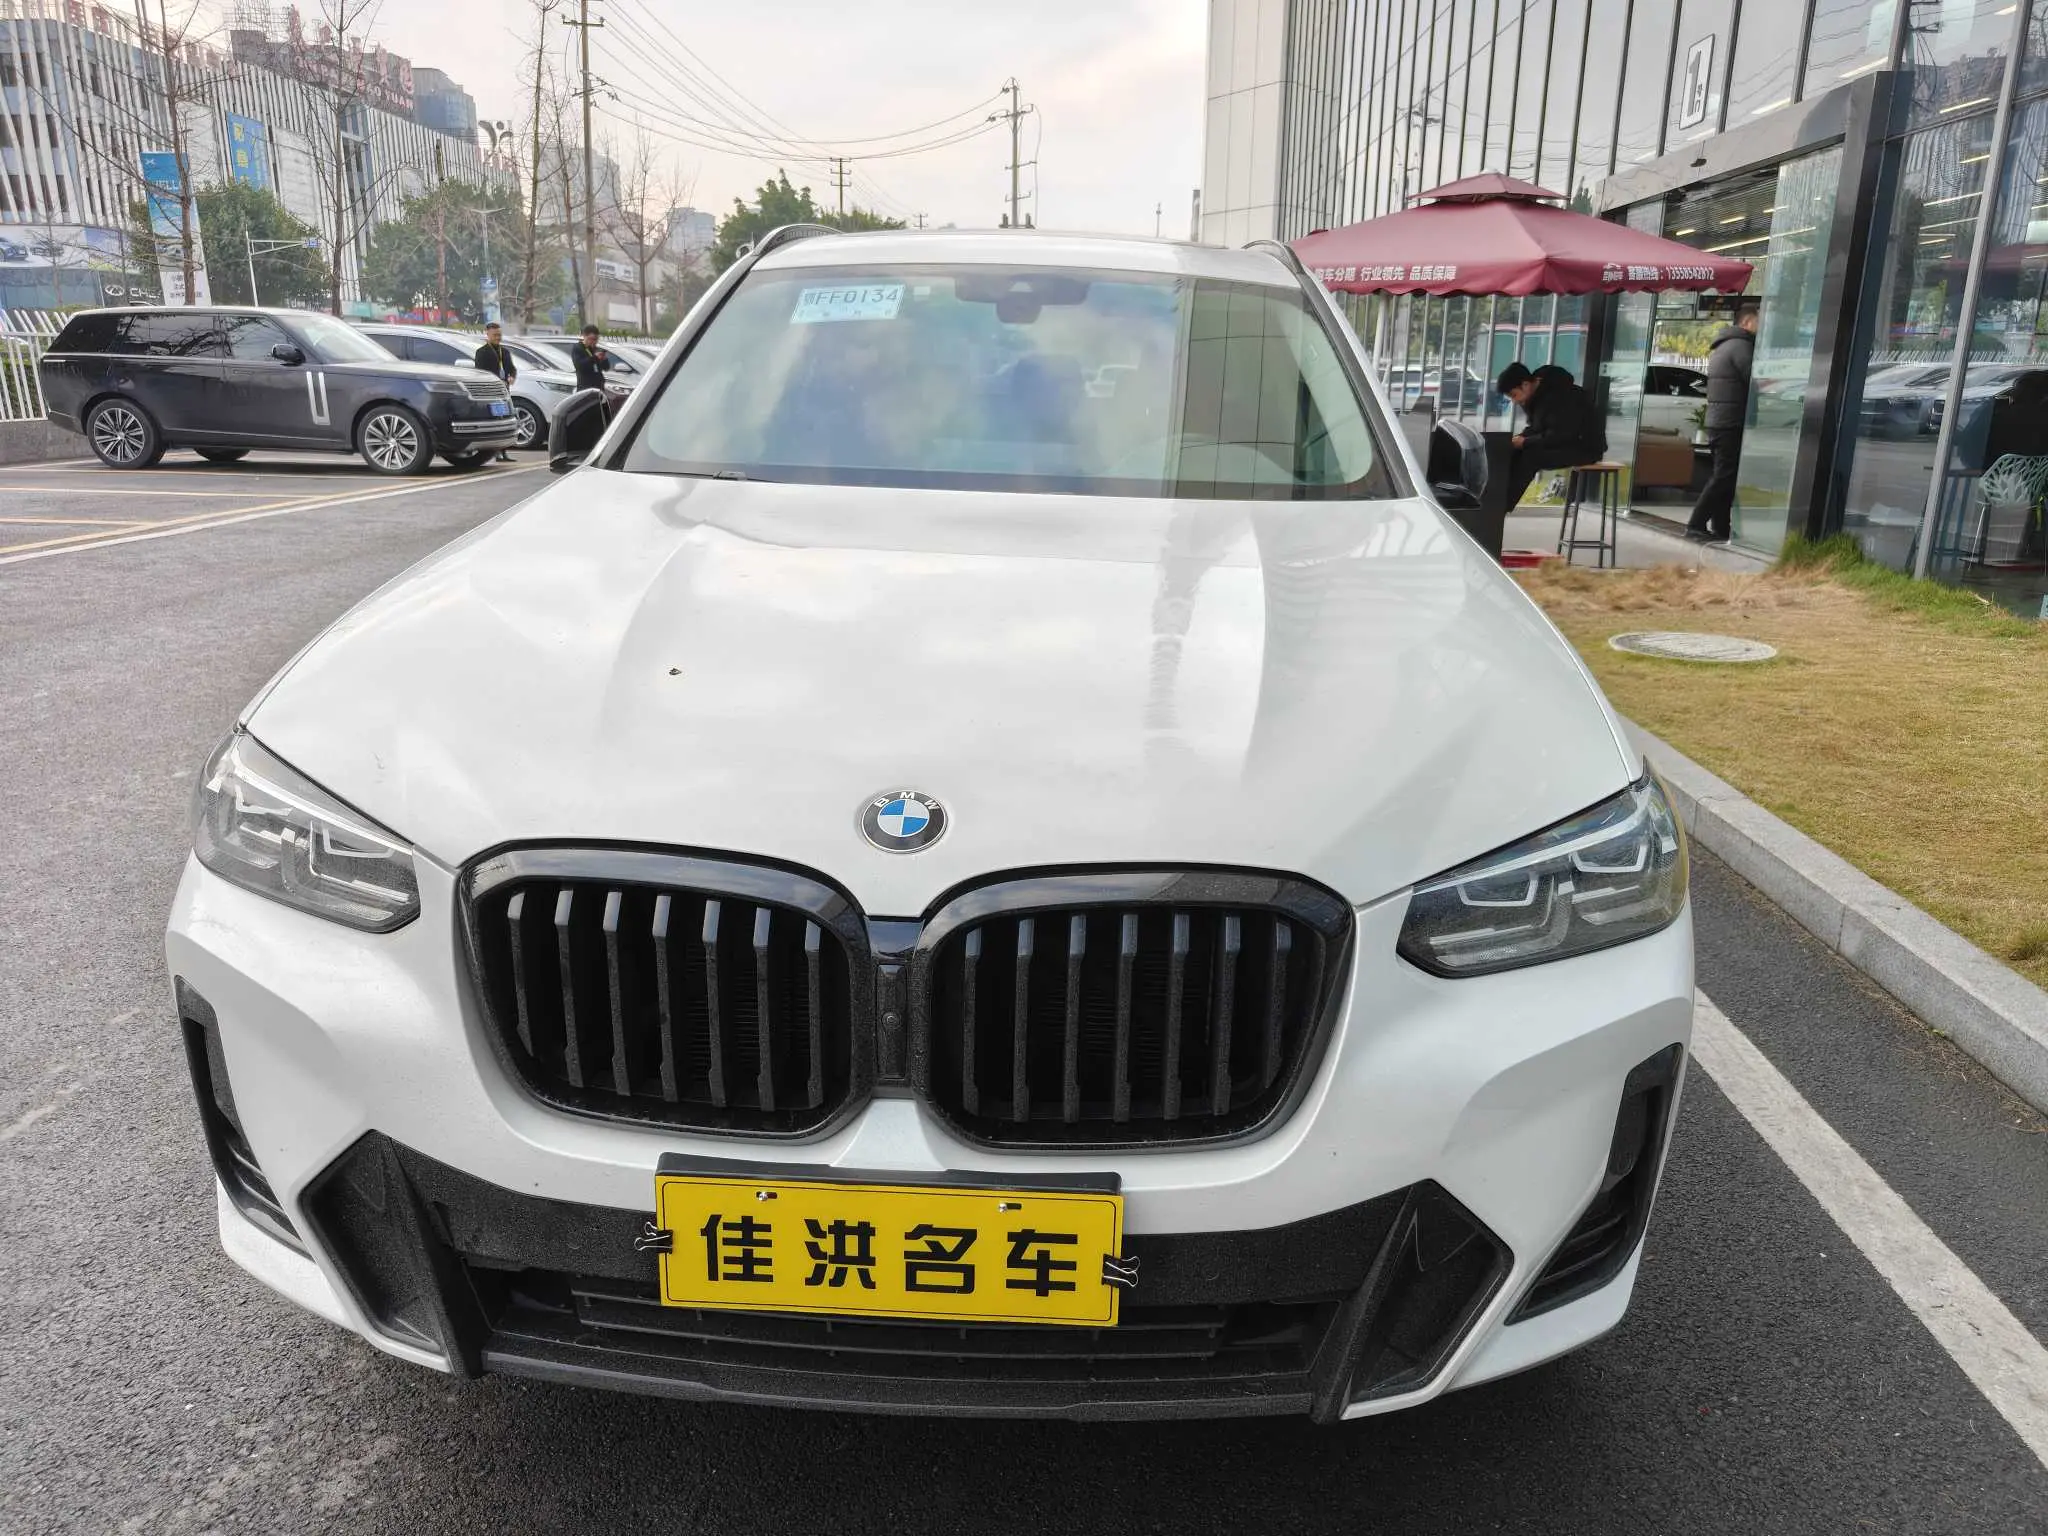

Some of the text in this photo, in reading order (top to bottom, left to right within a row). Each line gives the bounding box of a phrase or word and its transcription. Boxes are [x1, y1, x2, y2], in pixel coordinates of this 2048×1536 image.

[1687, 50, 1701, 117] 1
[1361, 266, 1405, 281] 行业领先
[1409, 265, 1457, 281] 品质保障
[873, 791, 941, 811] BMW
[699, 1212, 1080, 1298] 佳洪名车
